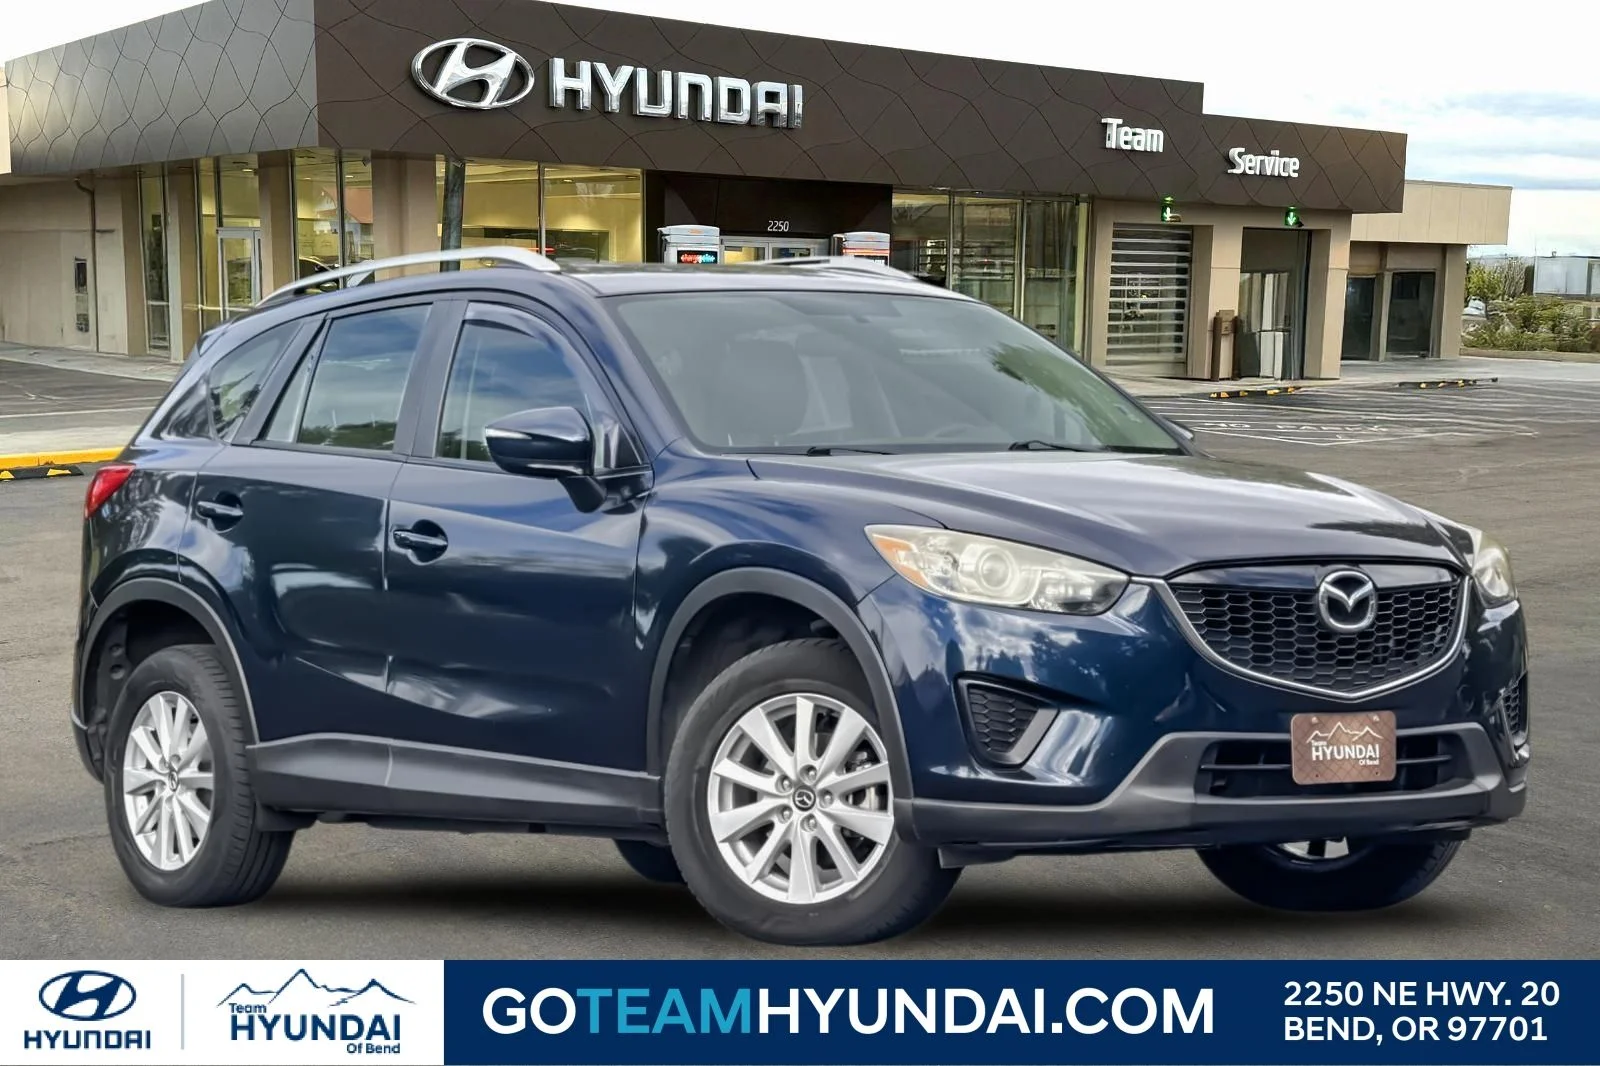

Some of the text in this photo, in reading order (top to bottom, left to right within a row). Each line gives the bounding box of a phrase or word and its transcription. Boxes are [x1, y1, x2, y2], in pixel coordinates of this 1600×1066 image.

[549, 57, 803, 129] HYUNDAI
[1101, 118, 1164, 152] Team
[1227, 147, 1300, 178] Service
[768, 220, 789, 232] 2250
[1312, 743, 1380, 761] HYUNDAI
